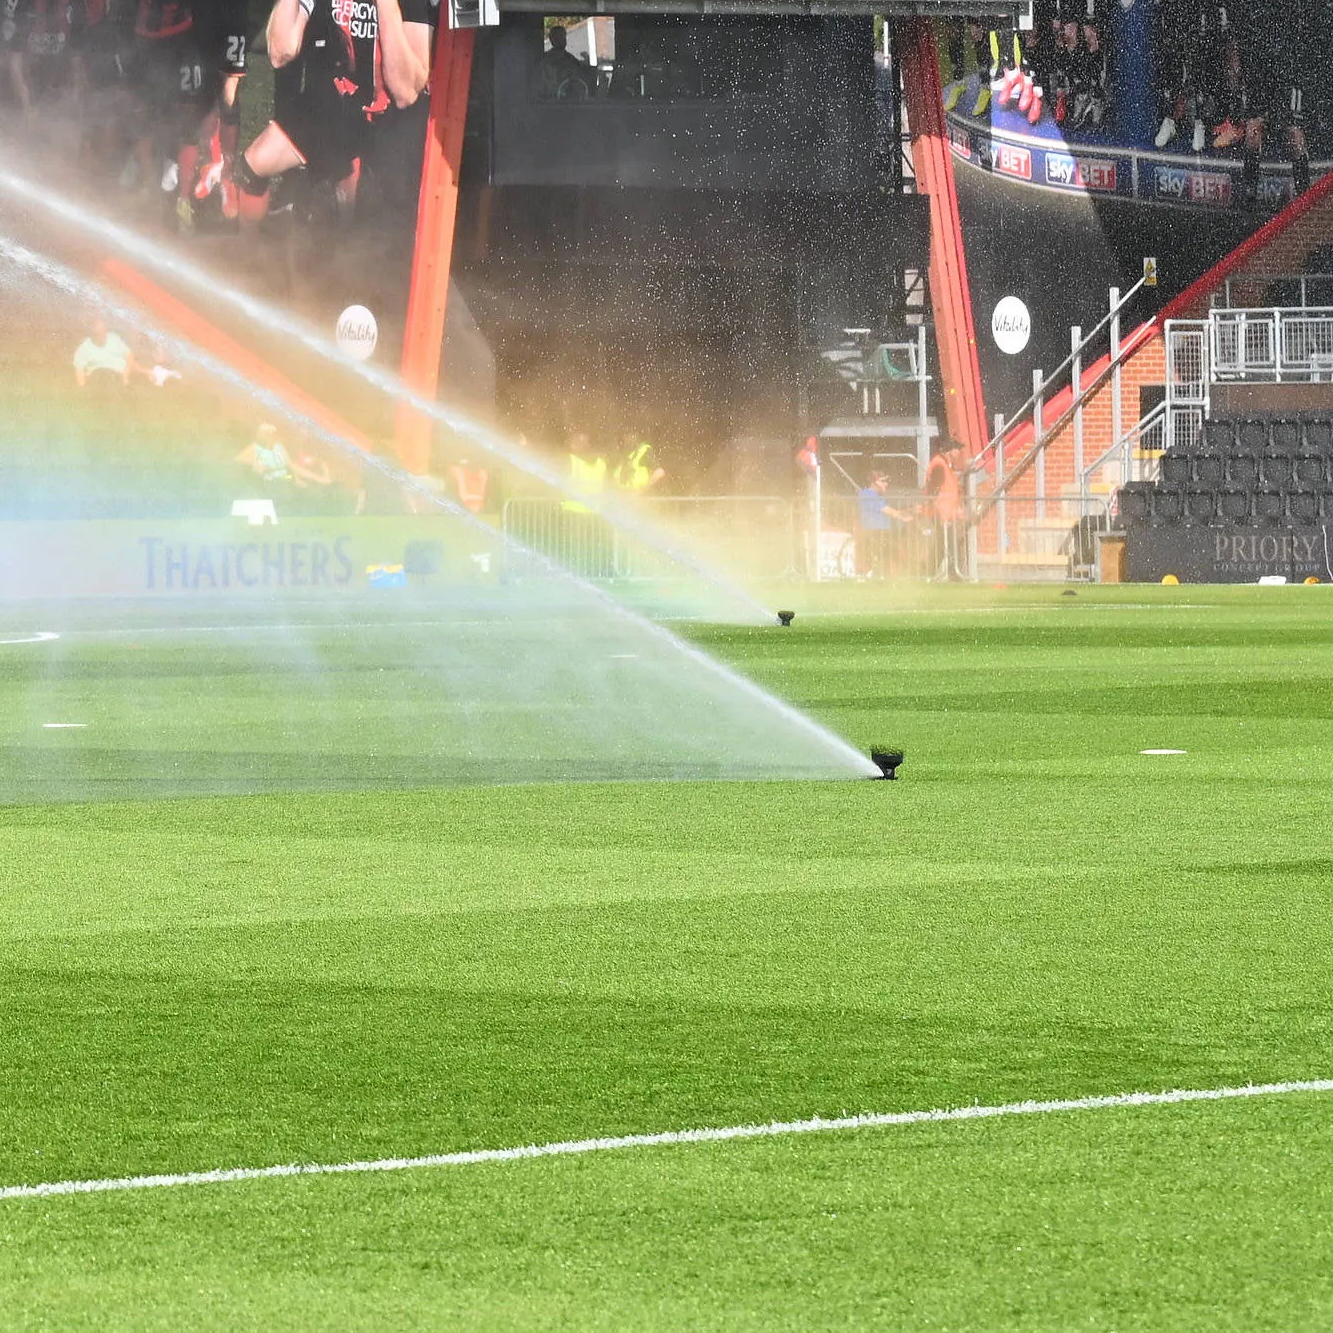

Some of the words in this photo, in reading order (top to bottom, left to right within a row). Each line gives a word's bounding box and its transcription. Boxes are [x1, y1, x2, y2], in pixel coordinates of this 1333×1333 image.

[1002, 151, 1029, 175] BET
[1047, 155, 1074, 183] sky
[1079, 162, 1112, 188] BET
[138, 535, 353, 590] THATCHERS
[1214, 535, 1318, 562] PRIORY
